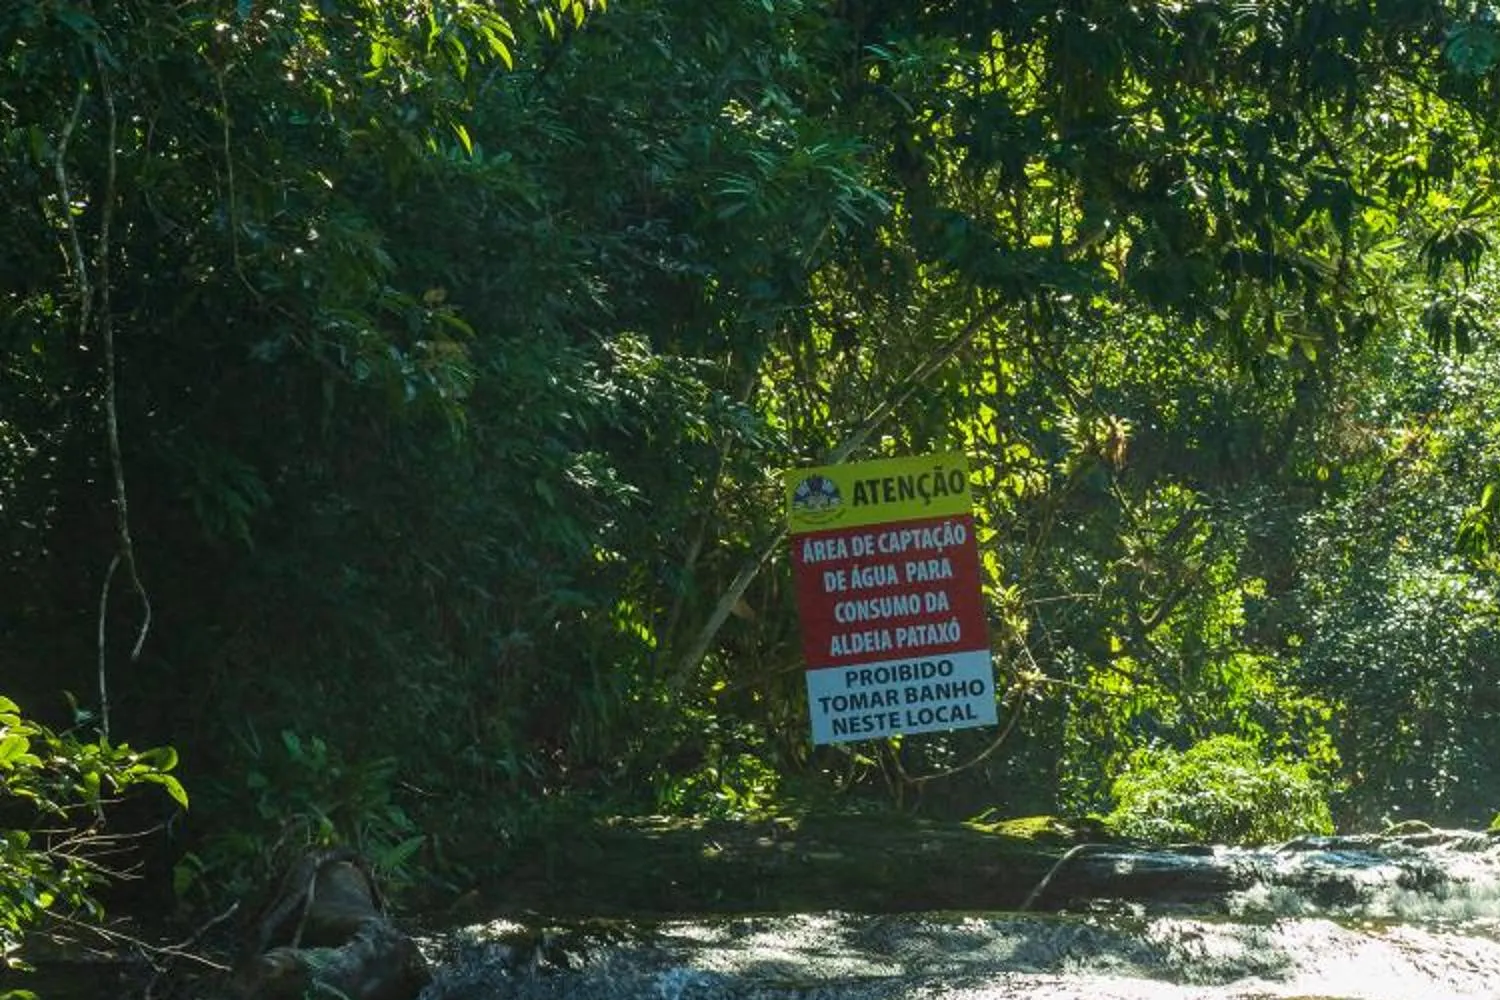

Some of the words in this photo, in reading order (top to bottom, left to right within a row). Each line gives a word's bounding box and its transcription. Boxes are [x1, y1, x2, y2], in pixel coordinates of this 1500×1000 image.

[852, 465, 965, 506] ATENÇÃO
[803, 536, 848, 564] ÁREA
[852, 533, 875, 556] DE
[878, 521, 966, 552] CAPTAÇÃO
[824, 570, 846, 592] DE
[851, 564, 898, 589] ÁGUA
[905, 558, 952, 582] PARA
[834, 595, 920, 623] CONSUMO
[925, 591, 949, 612] DA
[831, 628, 893, 657] ALDEIA
[896, 616, 961, 647] PATAXÓ
[845, 660, 954, 688] PROIBIDO
[818, 689, 899, 714] TOMAR
[904, 679, 985, 705] BANHO
[832, 712, 900, 736] NESTE
[906, 703, 977, 727] LOCAL
